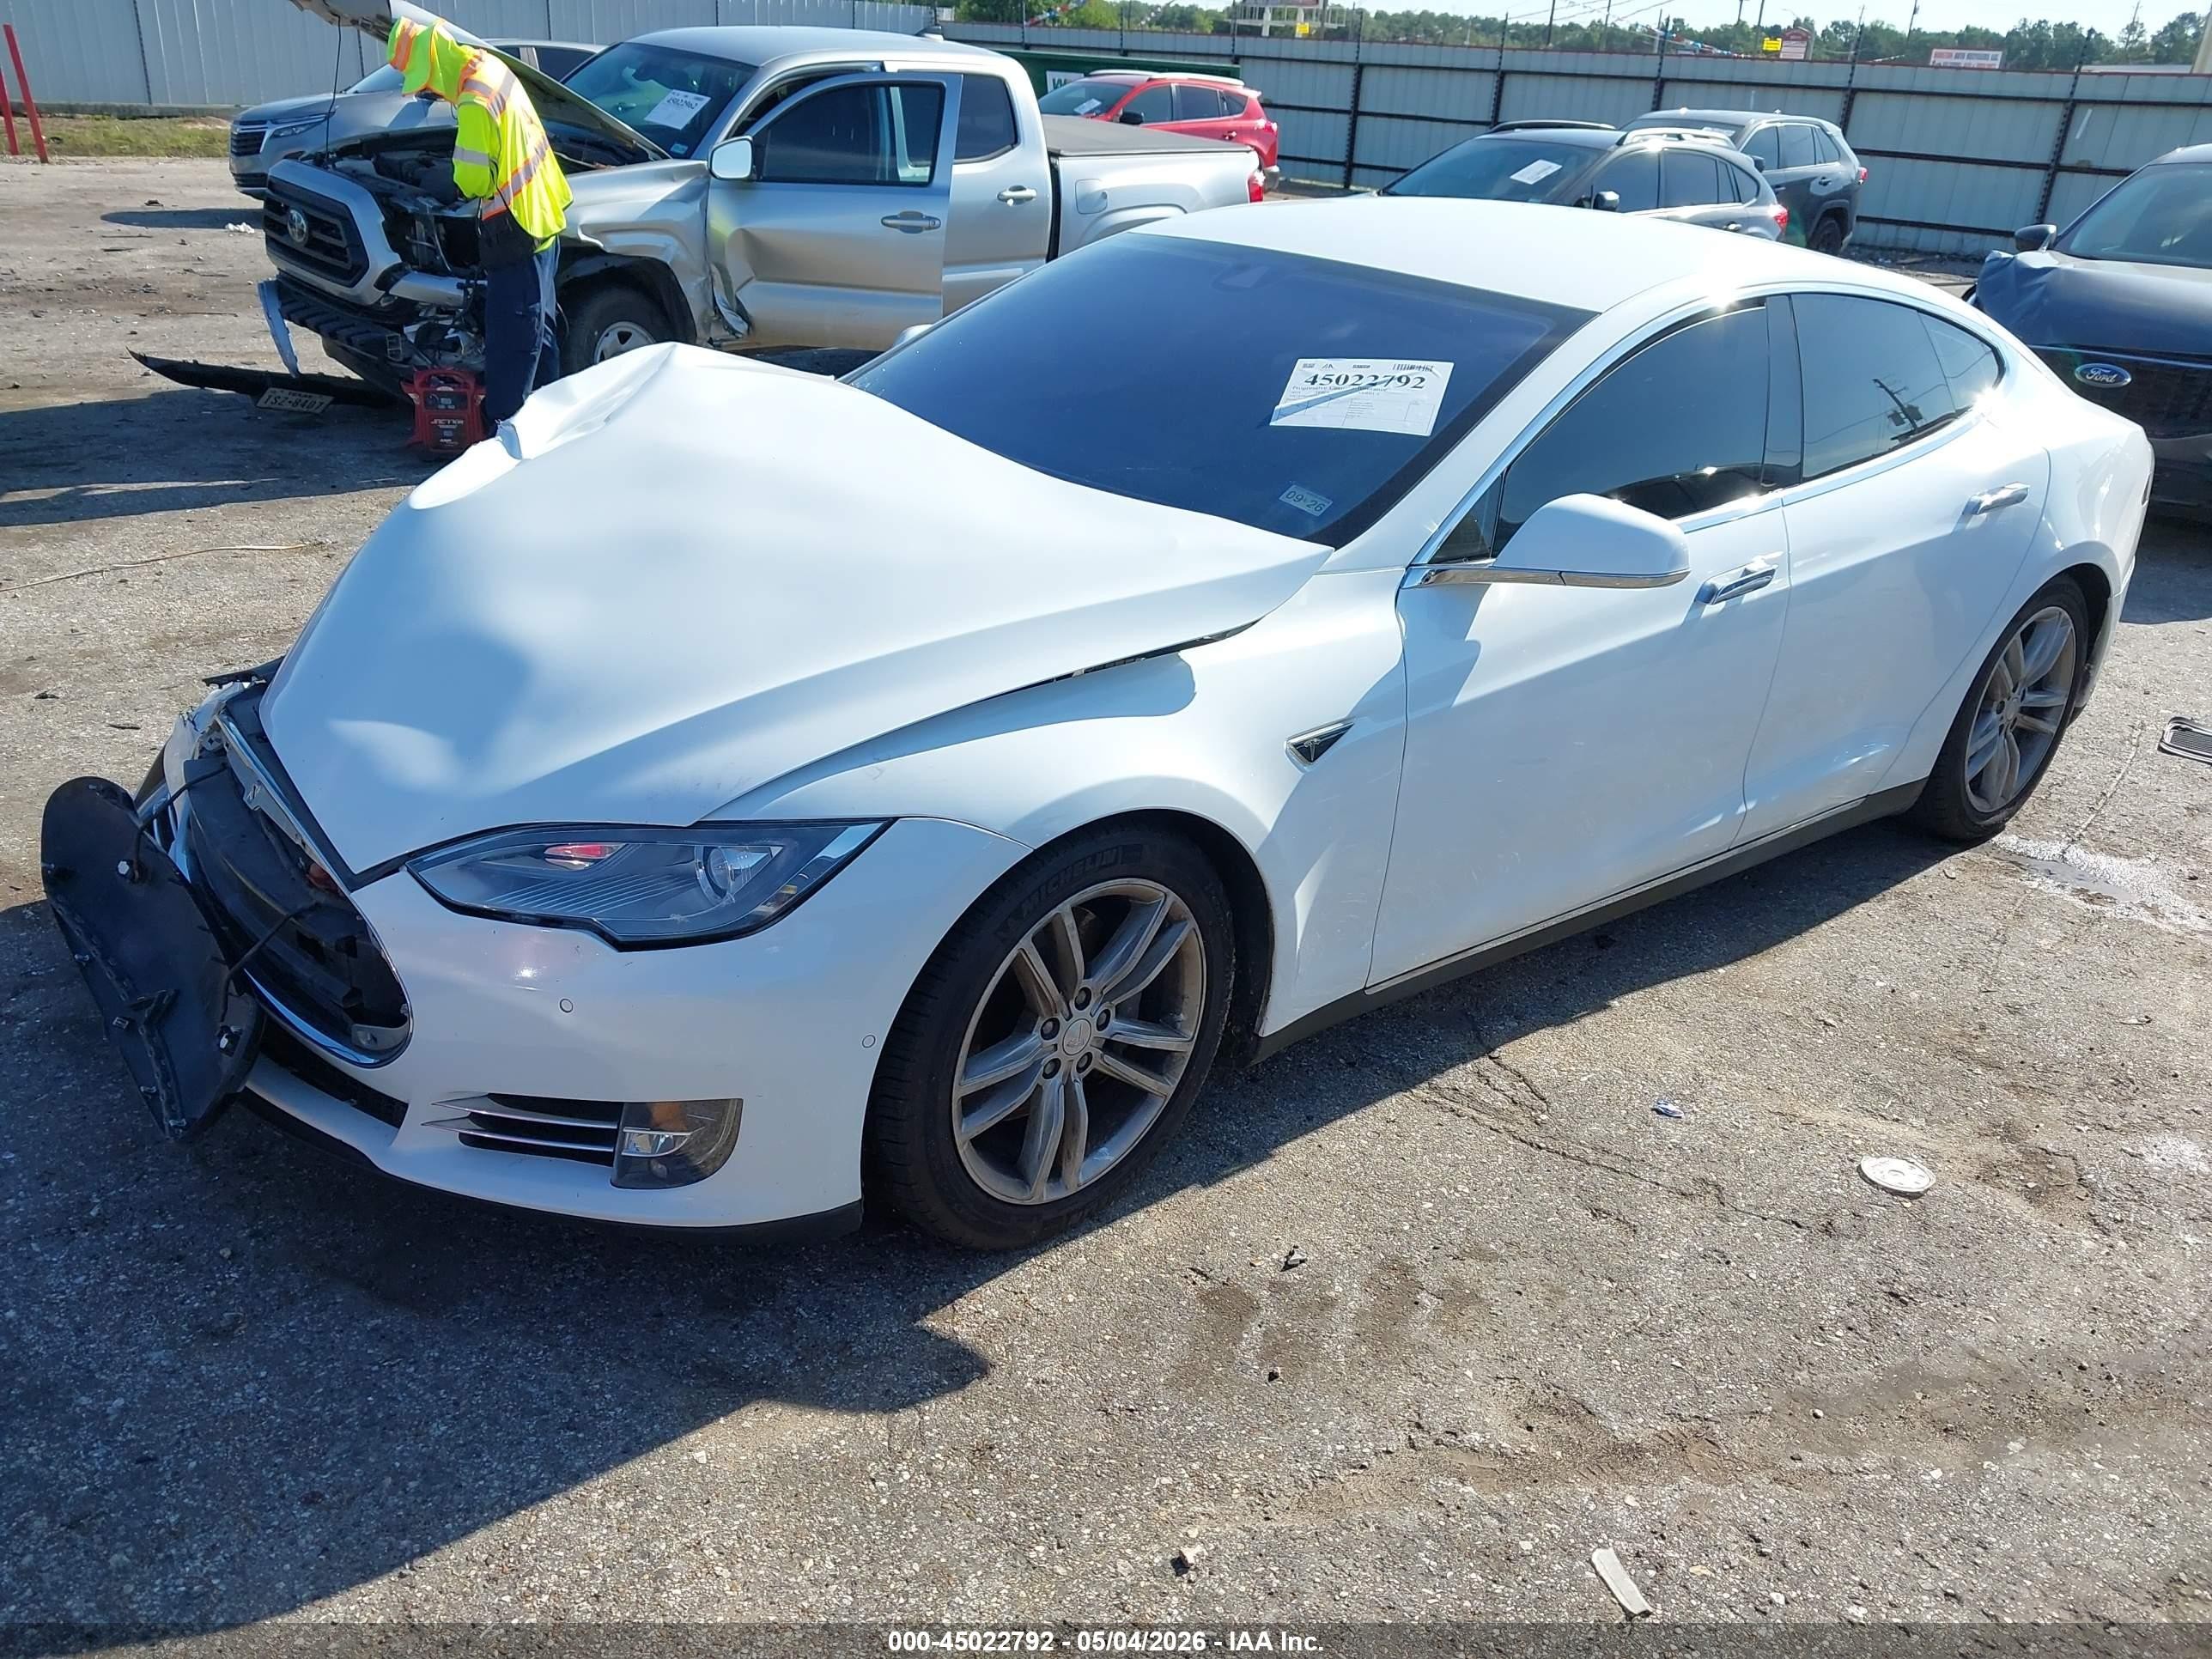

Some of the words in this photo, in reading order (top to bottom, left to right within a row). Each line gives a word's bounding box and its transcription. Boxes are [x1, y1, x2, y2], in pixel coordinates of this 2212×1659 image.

[1304, 374, 1425, 389] 45022792
[2086, 367, 2118, 383] Ford
[1285, 490, 1304, 502] 09
[1306, 500, 1326, 512] 26
[1019, 843, 1123, 917] MICHELIN
